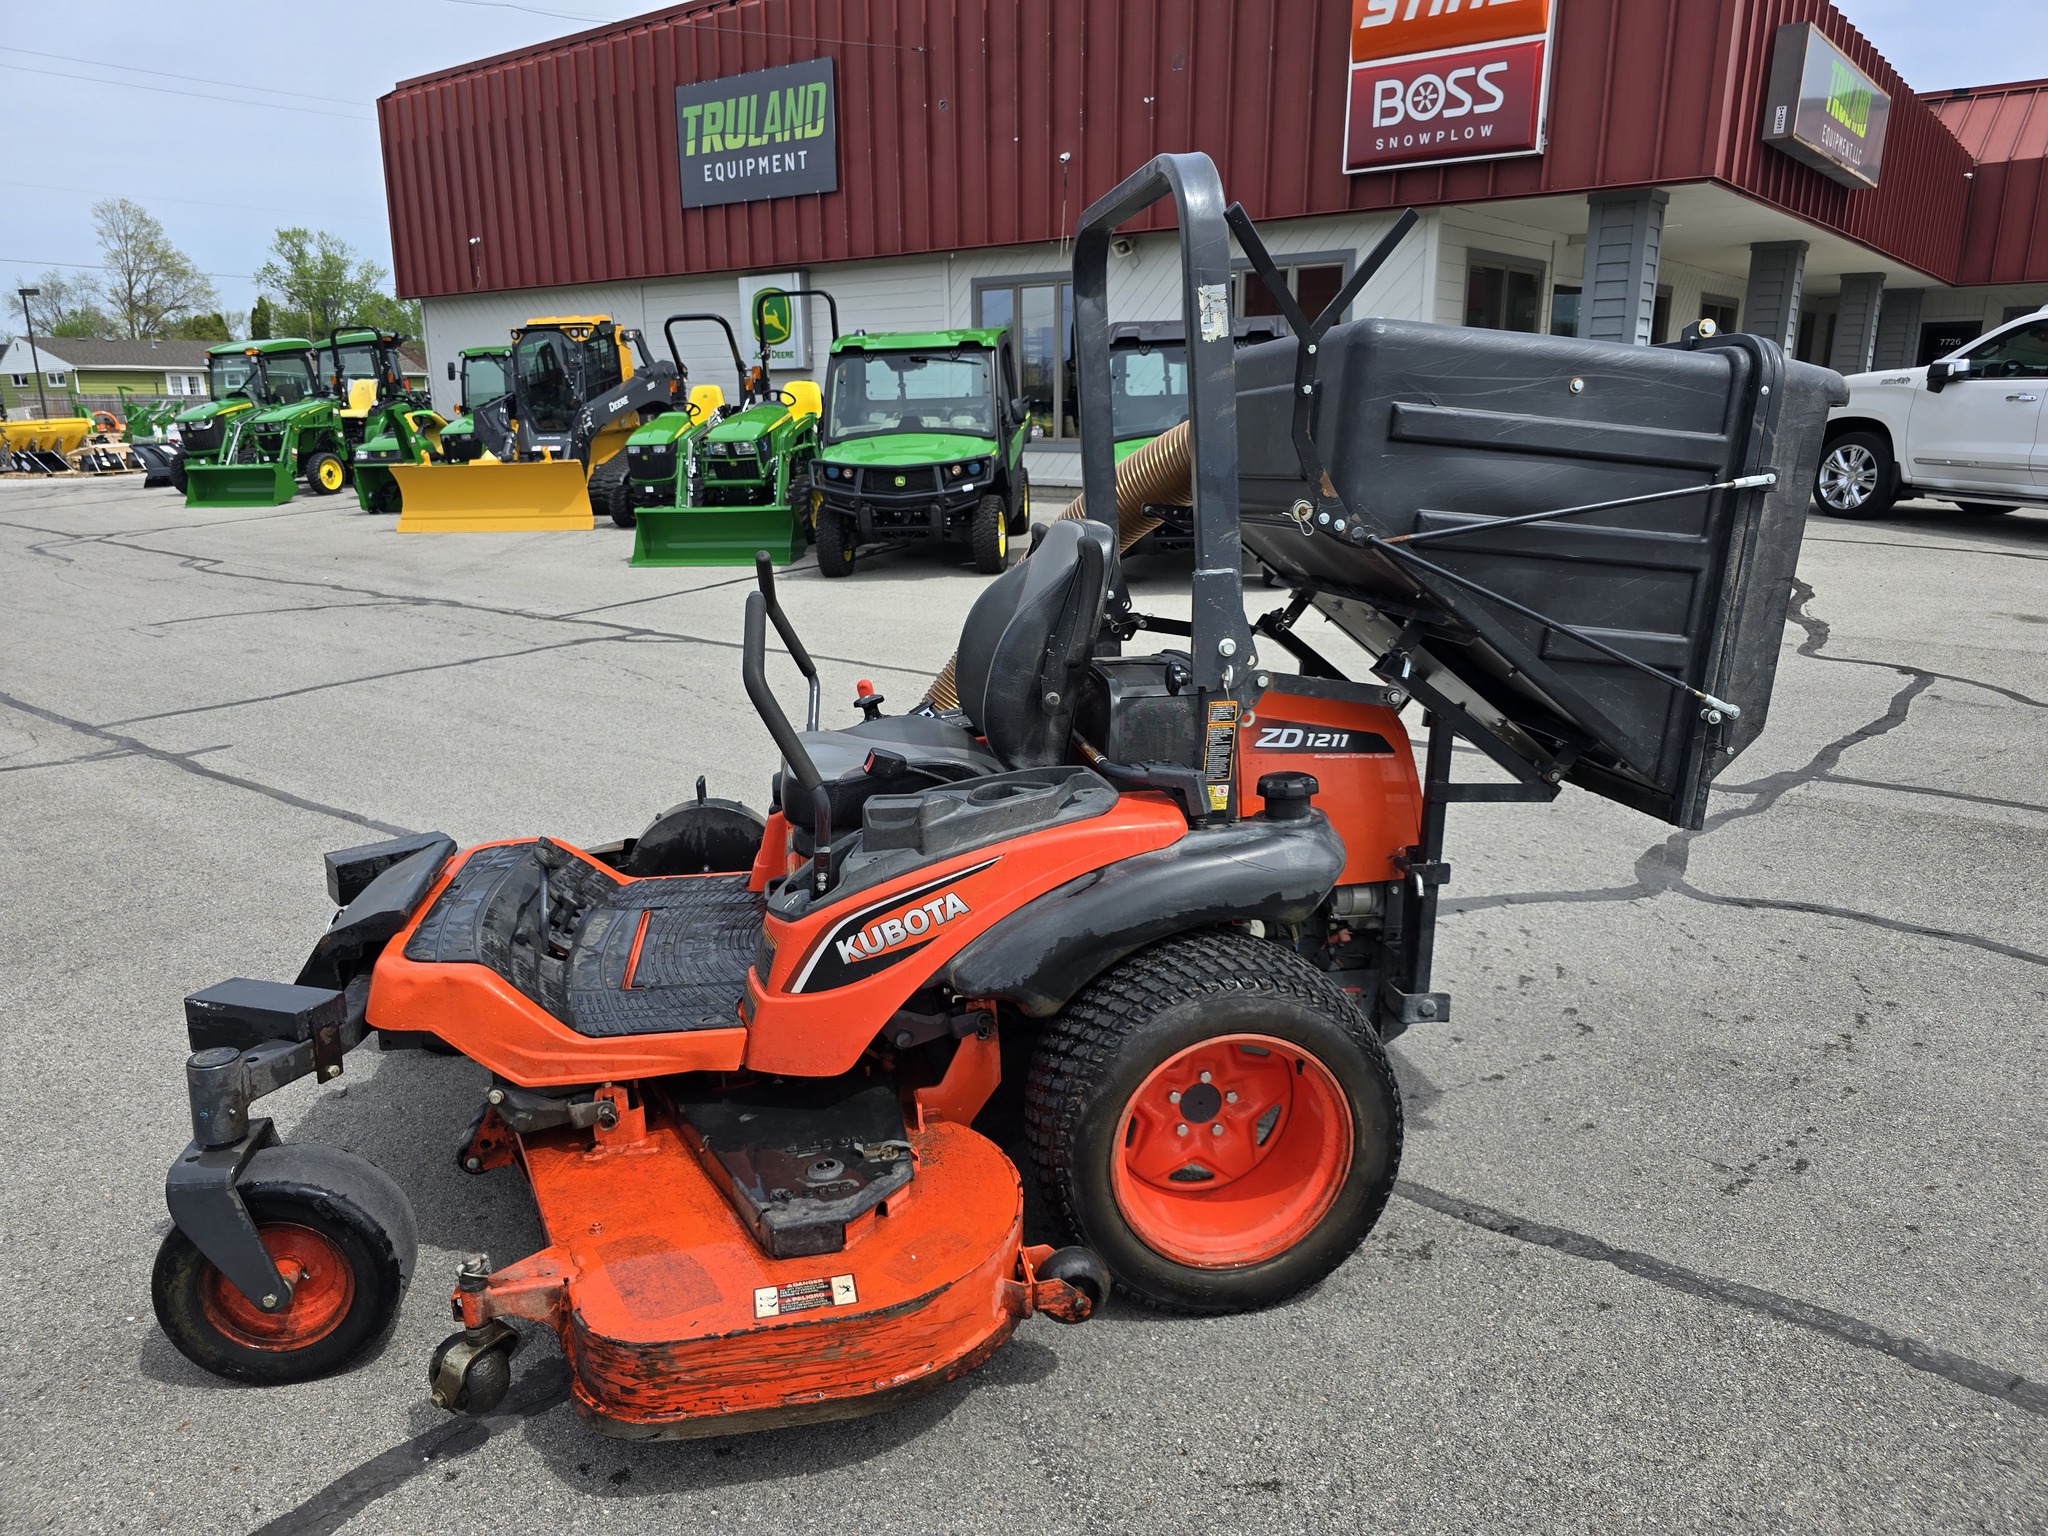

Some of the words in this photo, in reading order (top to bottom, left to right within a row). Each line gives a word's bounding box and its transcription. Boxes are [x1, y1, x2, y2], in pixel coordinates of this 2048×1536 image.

[1372, 61, 1508, 128] BOSS
[1826, 59, 1872, 138] TRULAND
[683, 81, 827, 157] TRULAND
[1375, 124, 1493, 150] SNOWPLOW
[703, 150, 808, 182] EQUIPMENT
[1940, 338, 1961, 346] 7726
[772, 350, 795, 360] DEERE
[608, 395, 630, 413] DEERE
[1254, 728, 1304, 748] ZD
[1306, 733, 1350, 748] 1211
[835, 891, 972, 965] KUBOTA
[792, 1278, 824, 1287] DANGER
[792, 1292, 825, 1302] PELIGRO
